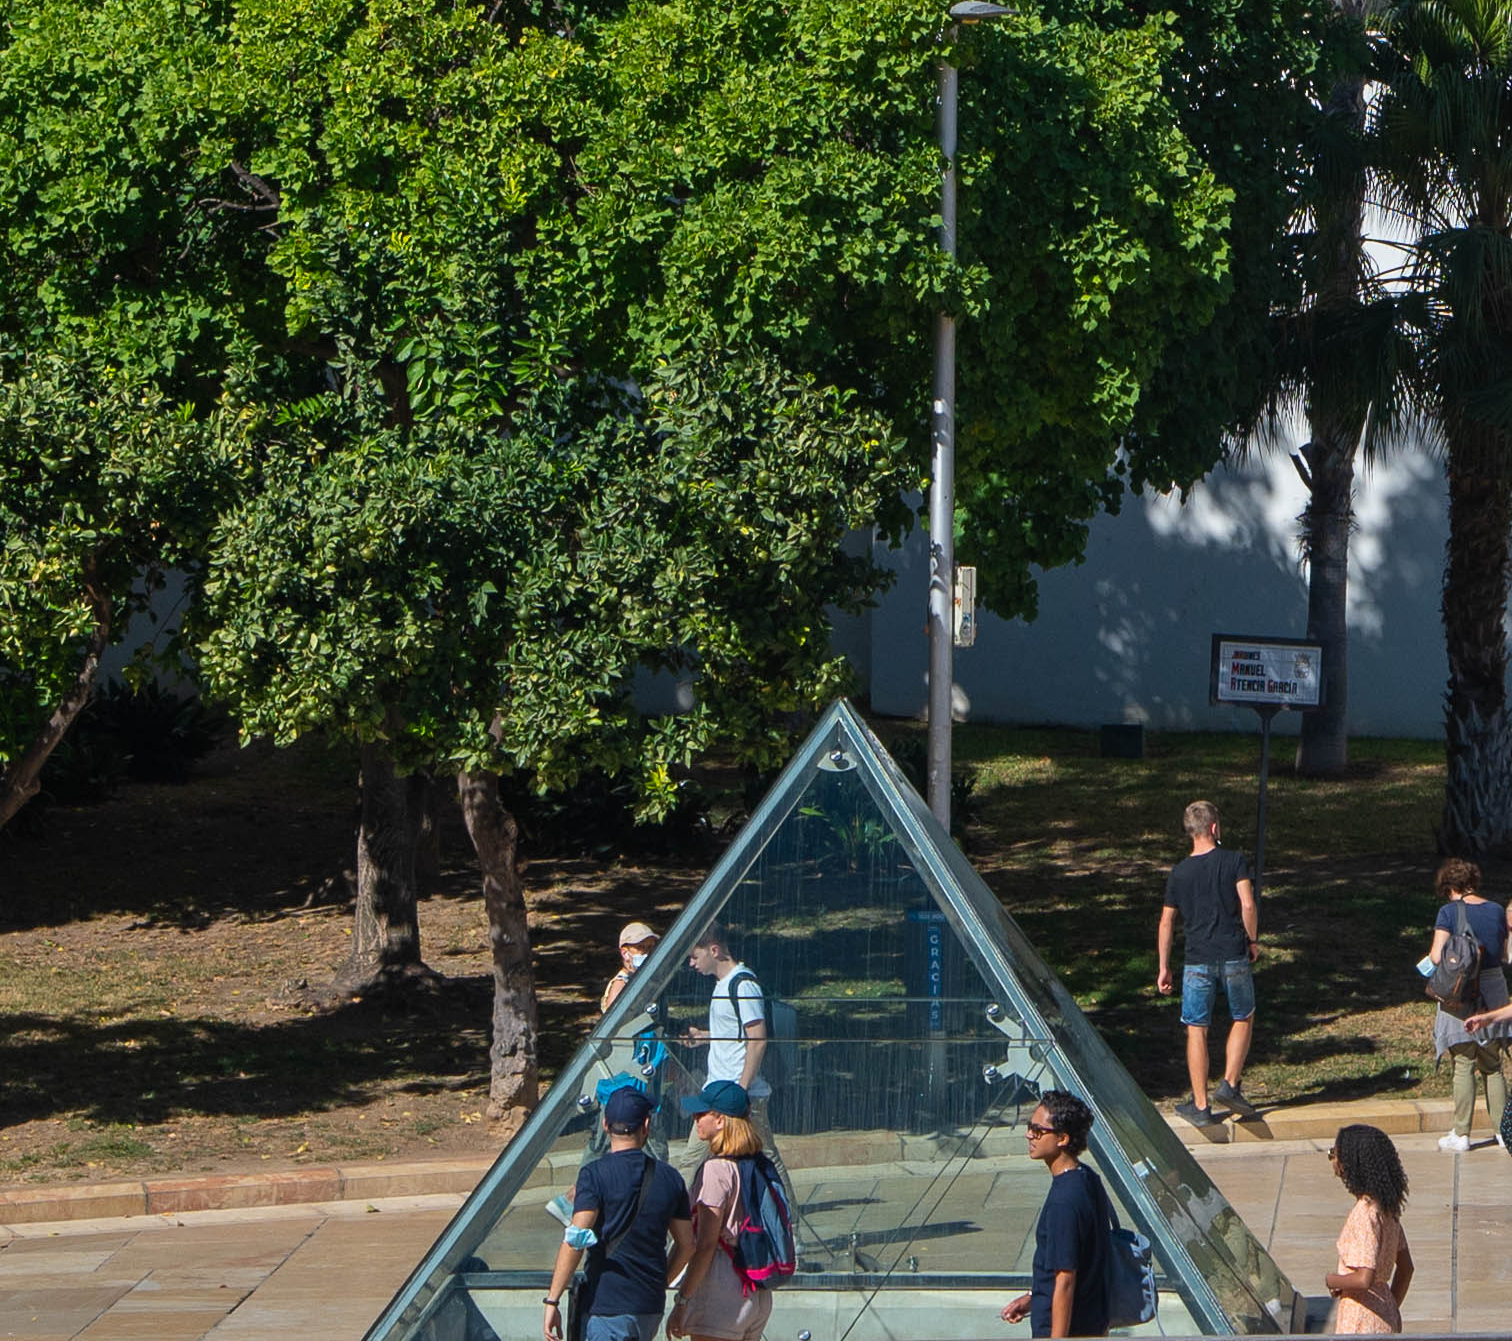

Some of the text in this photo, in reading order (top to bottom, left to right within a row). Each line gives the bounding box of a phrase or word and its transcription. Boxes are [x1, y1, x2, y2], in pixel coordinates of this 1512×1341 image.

[1232, 662, 1265, 676] MANUEL
[1231, 678, 1297, 693] ATENCIA GARCÍA
[930, 935, 940, 1019] GRACIAS
